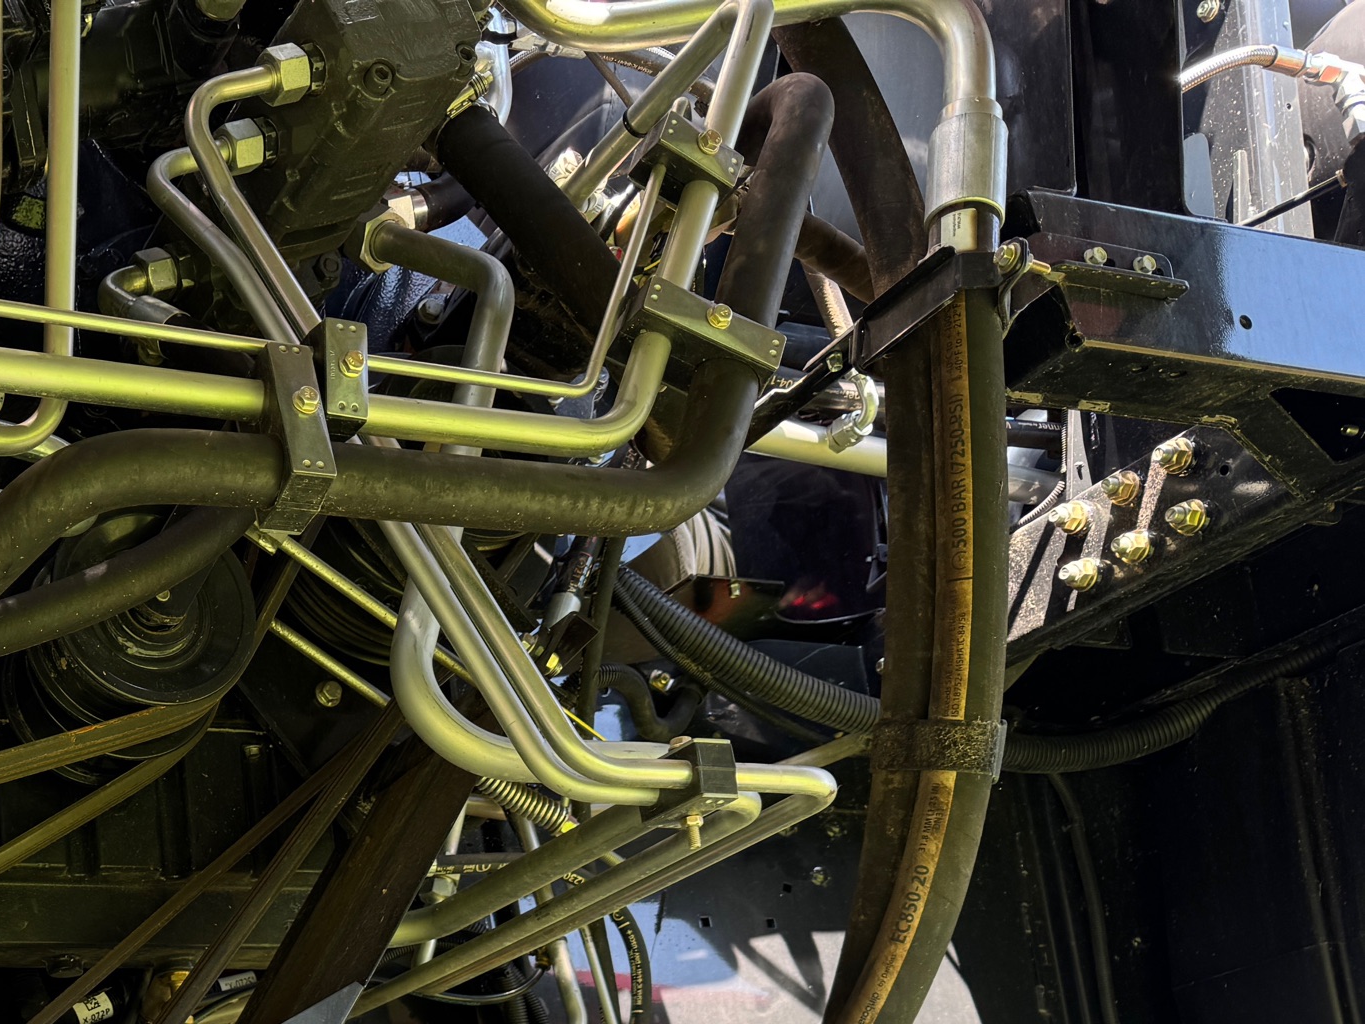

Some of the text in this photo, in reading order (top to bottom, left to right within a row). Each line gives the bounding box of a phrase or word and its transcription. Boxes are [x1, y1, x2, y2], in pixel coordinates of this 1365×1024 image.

[951, 477, 966, 513] BAR
[952, 517, 967, 548] 500
[895, 864, 930, 944] EC850-20
[82, 1008, 111, 1024] X-072P
